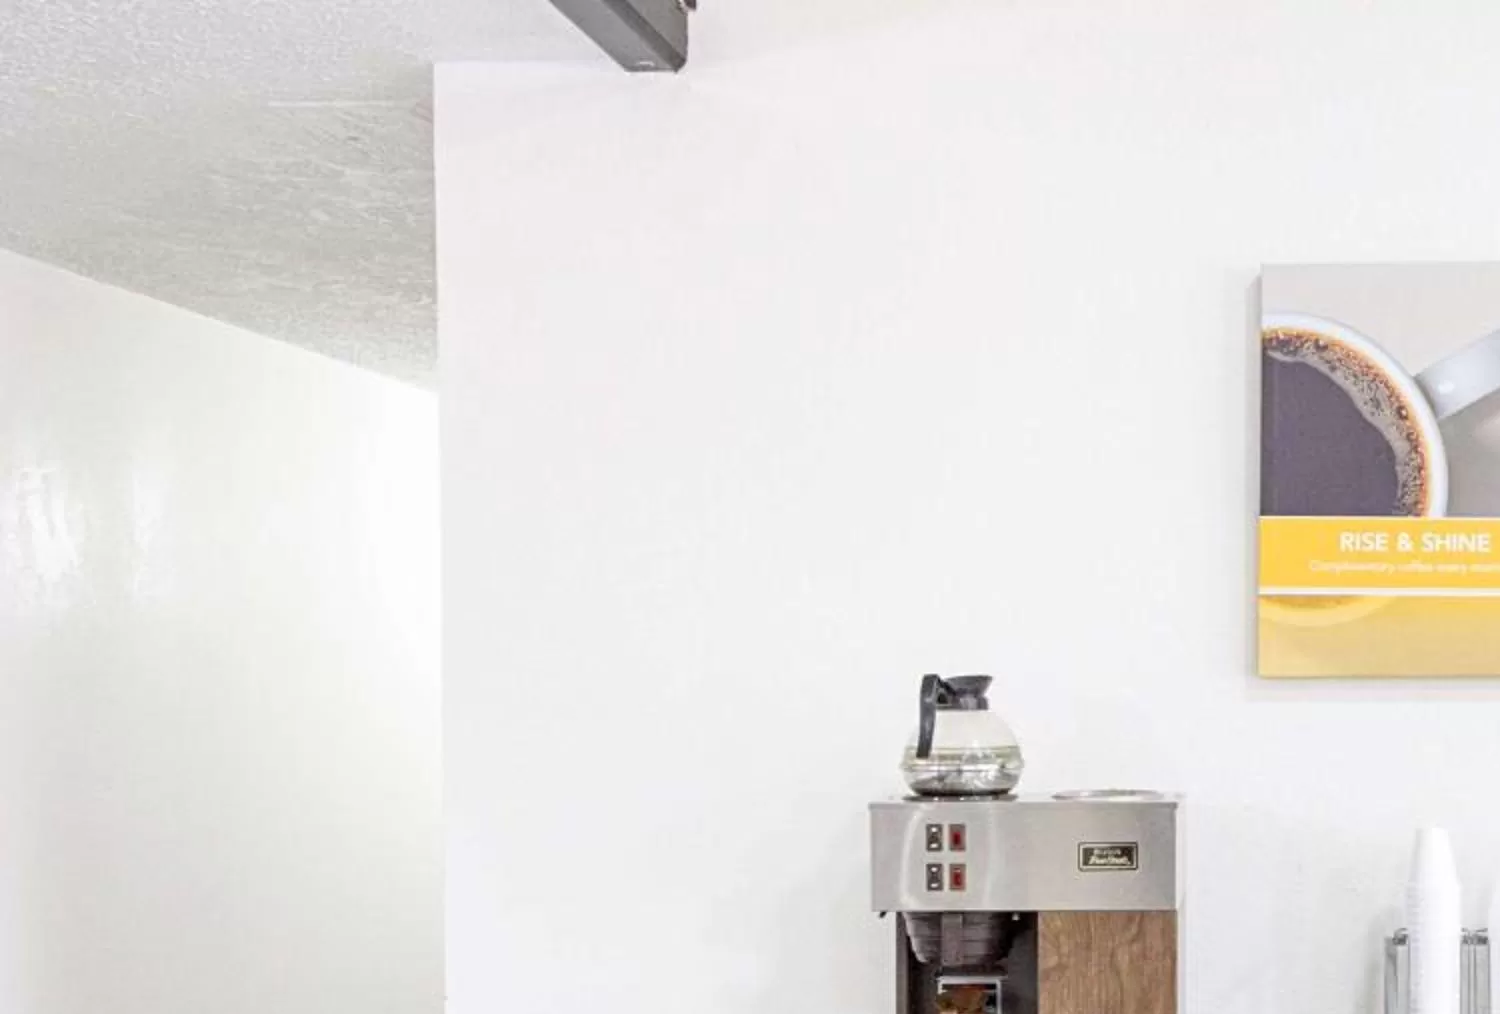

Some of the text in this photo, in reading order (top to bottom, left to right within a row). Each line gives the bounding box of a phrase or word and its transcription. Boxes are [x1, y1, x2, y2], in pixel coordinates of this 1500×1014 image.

[1340, 531, 1491, 552] RISE & SHINE
